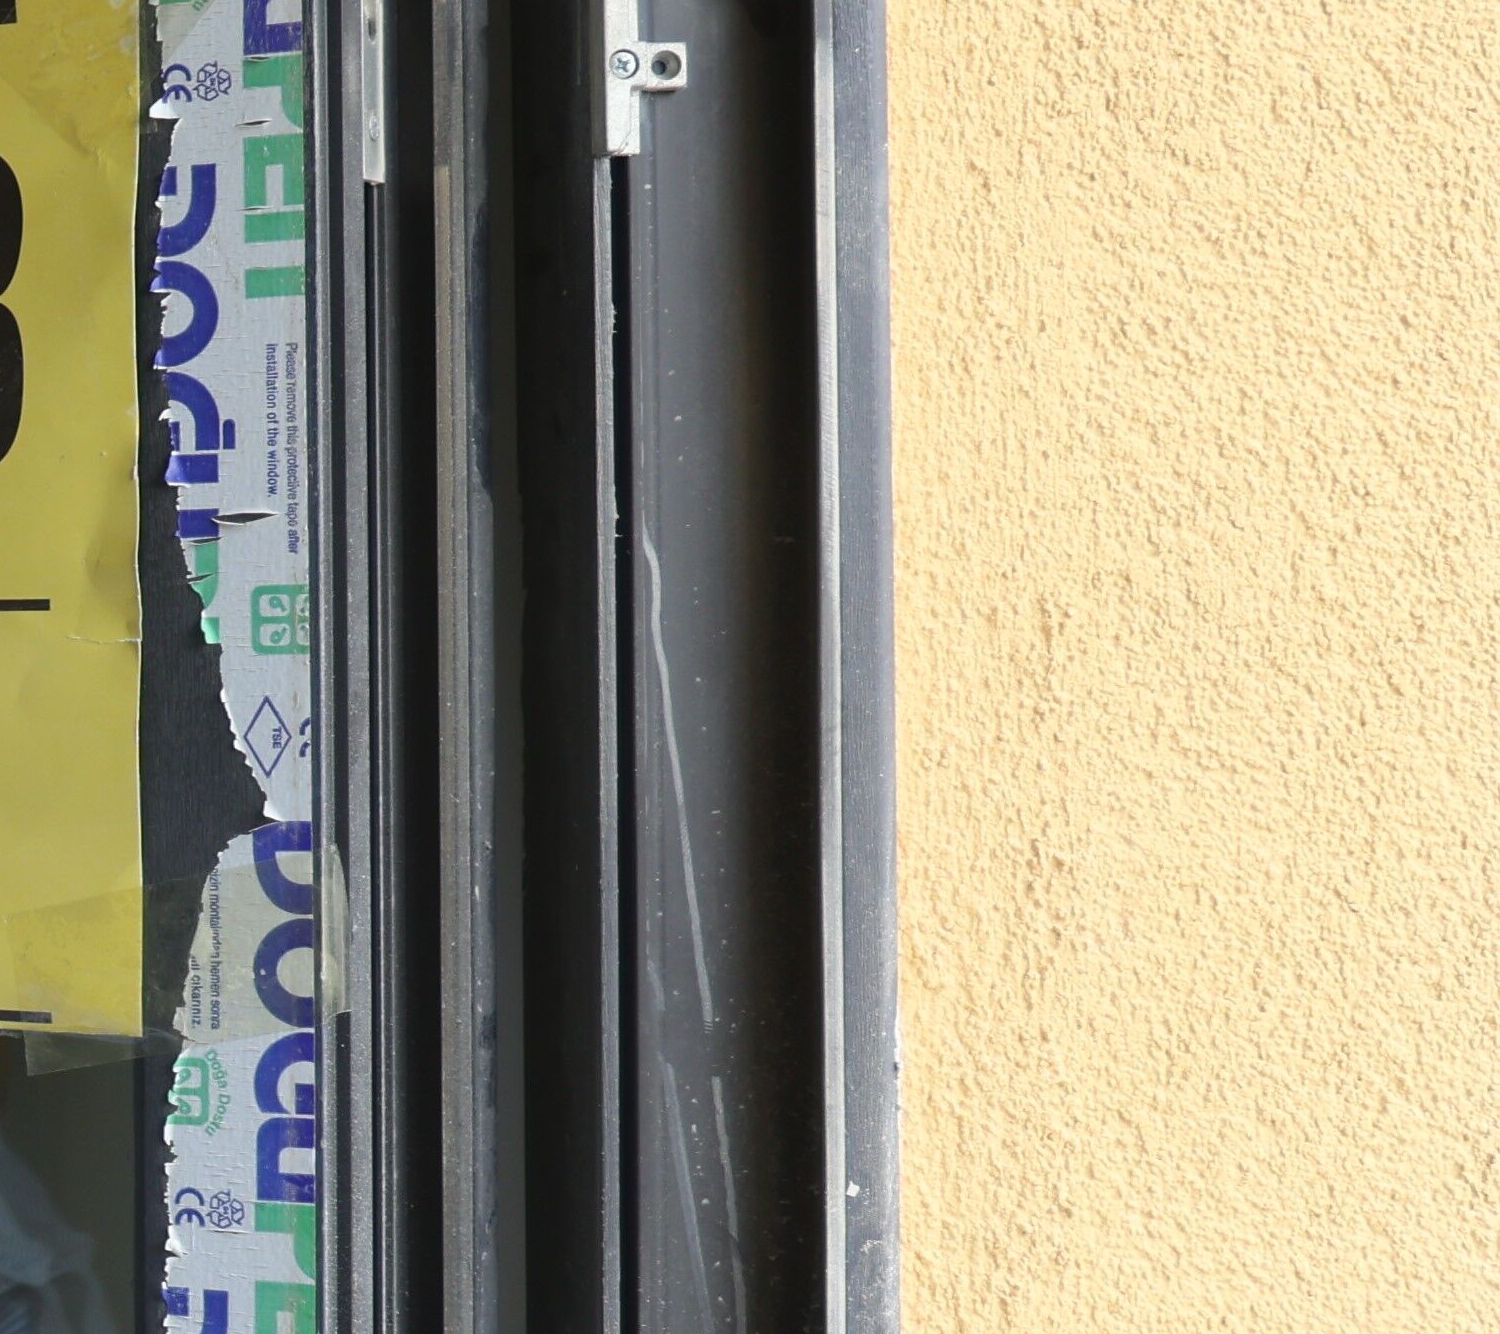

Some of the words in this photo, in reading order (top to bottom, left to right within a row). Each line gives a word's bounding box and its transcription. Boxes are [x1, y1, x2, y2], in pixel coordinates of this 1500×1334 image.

[285, 342, 298, 380] Please
[266, 343, 280, 410] installation
[285, 382, 298, 423] remove
[267, 412, 280, 425] of
[267, 428, 280, 446] the
[286, 425, 300, 445] this
[267, 450, 280, 498] window.
[284, 447, 300, 504] protective
[285, 506, 300, 527] tape
[287, 529, 300, 555] after
[272, 726, 283, 749] TSE
[210, 960, 222, 997] hemen
[210, 1000, 222, 1029] sonra
